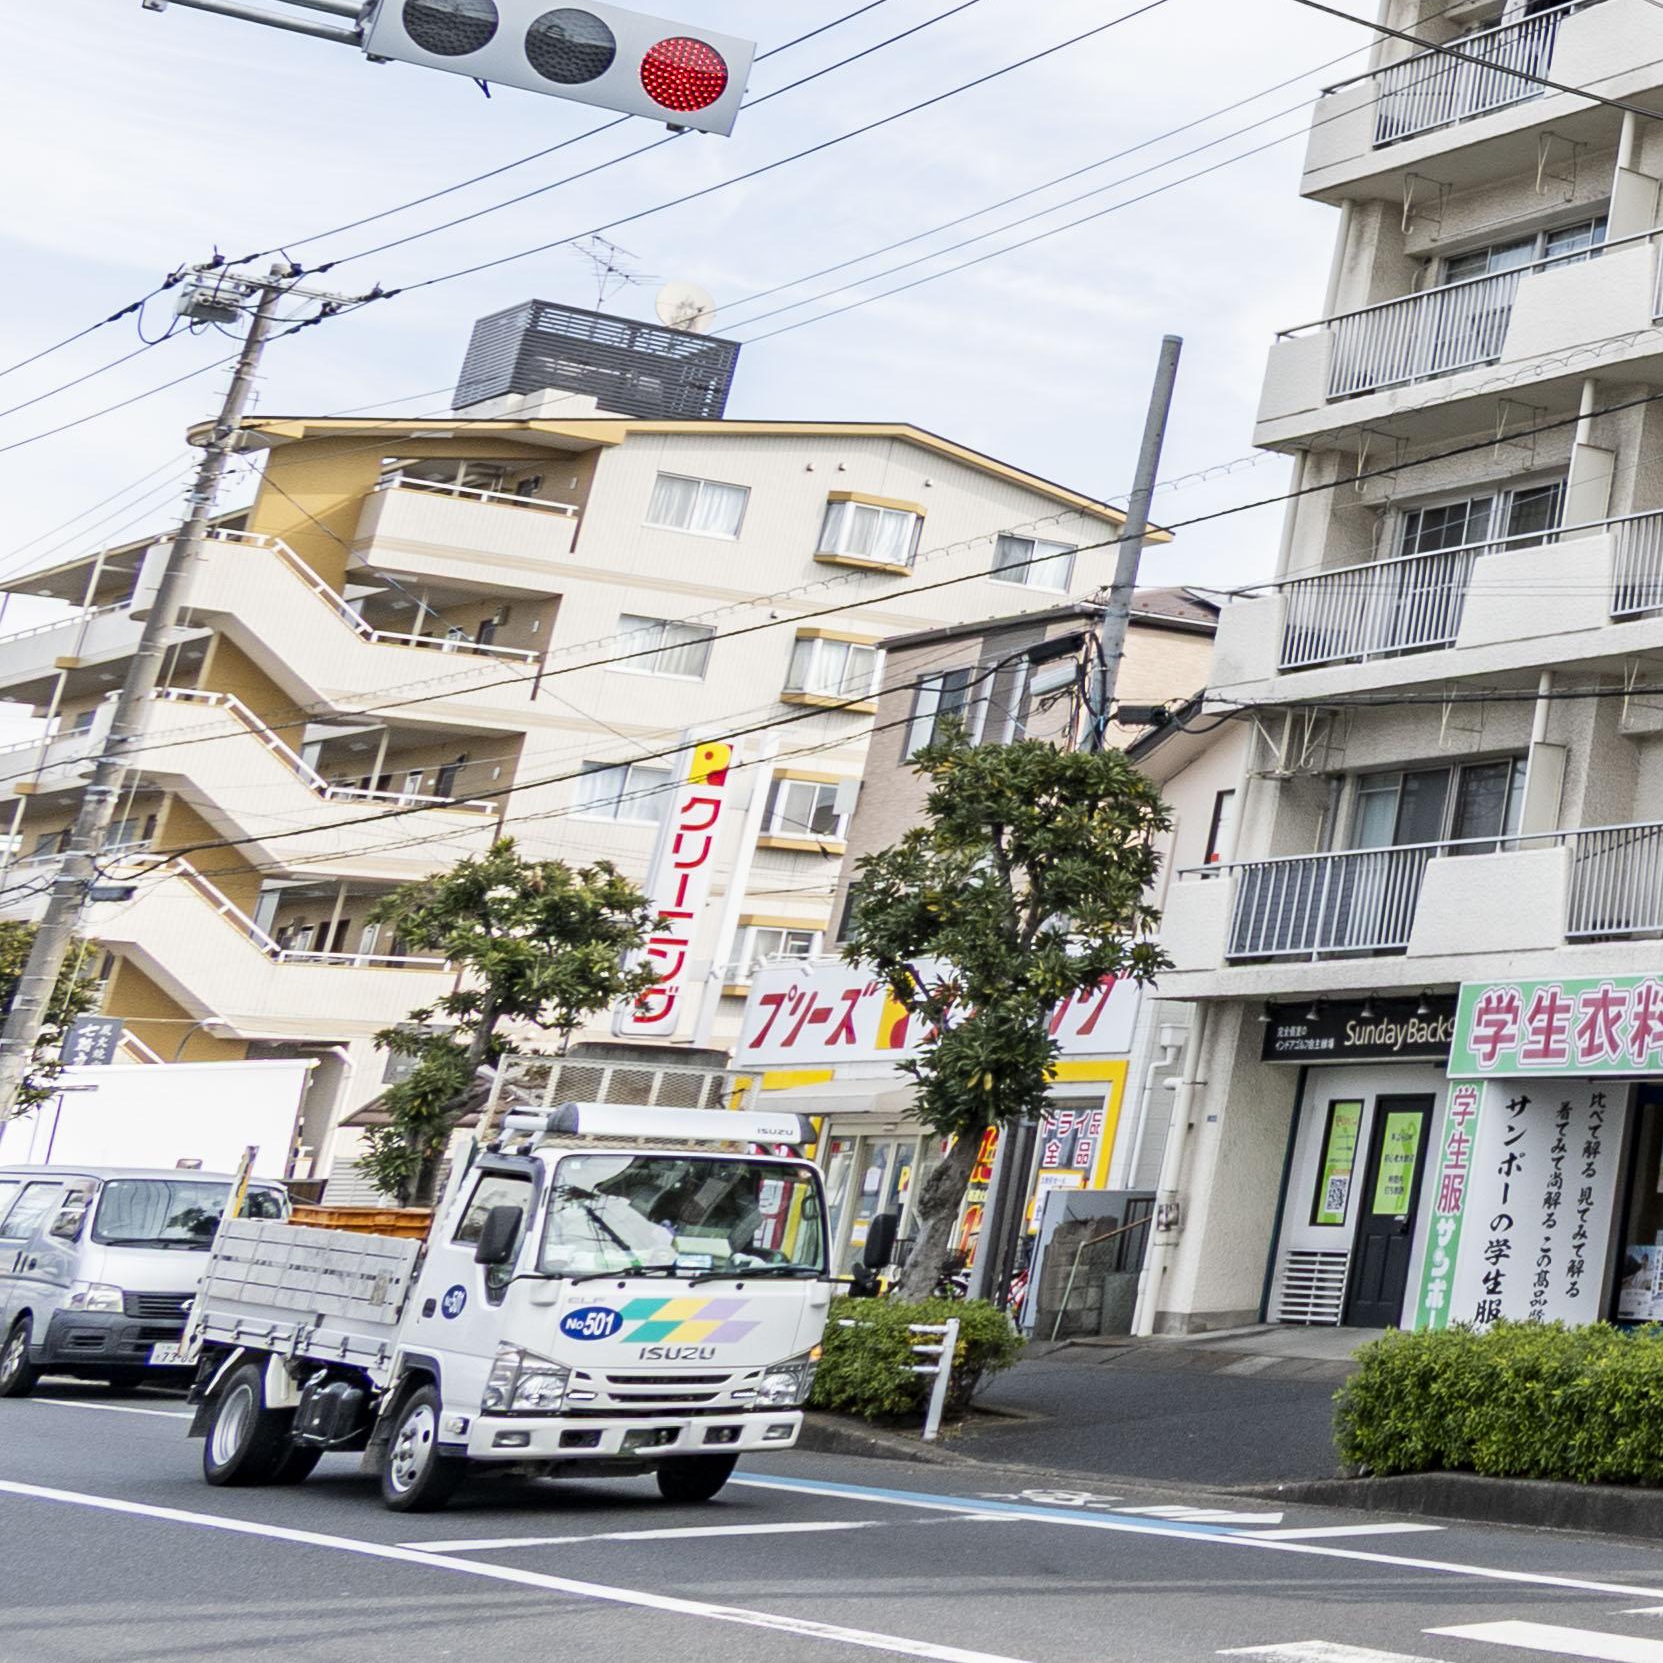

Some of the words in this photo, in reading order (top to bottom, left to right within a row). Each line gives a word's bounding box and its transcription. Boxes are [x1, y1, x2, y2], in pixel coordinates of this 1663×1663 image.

[632, 796, 722, 1024] クリーニング
[748, 981, 880, 1049] プリーズ
[756, 1127, 794, 1136] ISUZU
[1437, 1086, 1478, 1214] 学生服
[1541, 1101, 1574, 1230] 着てみて尚解る
[1581, 1091, 1607, 1179] 比べて解る
[1474, 1095, 1532, 1325] サンポーの学生服
[1565, 1186, 1594, 1299] 見てみて解る
[638, 1346, 717, 1361] ISUZU
